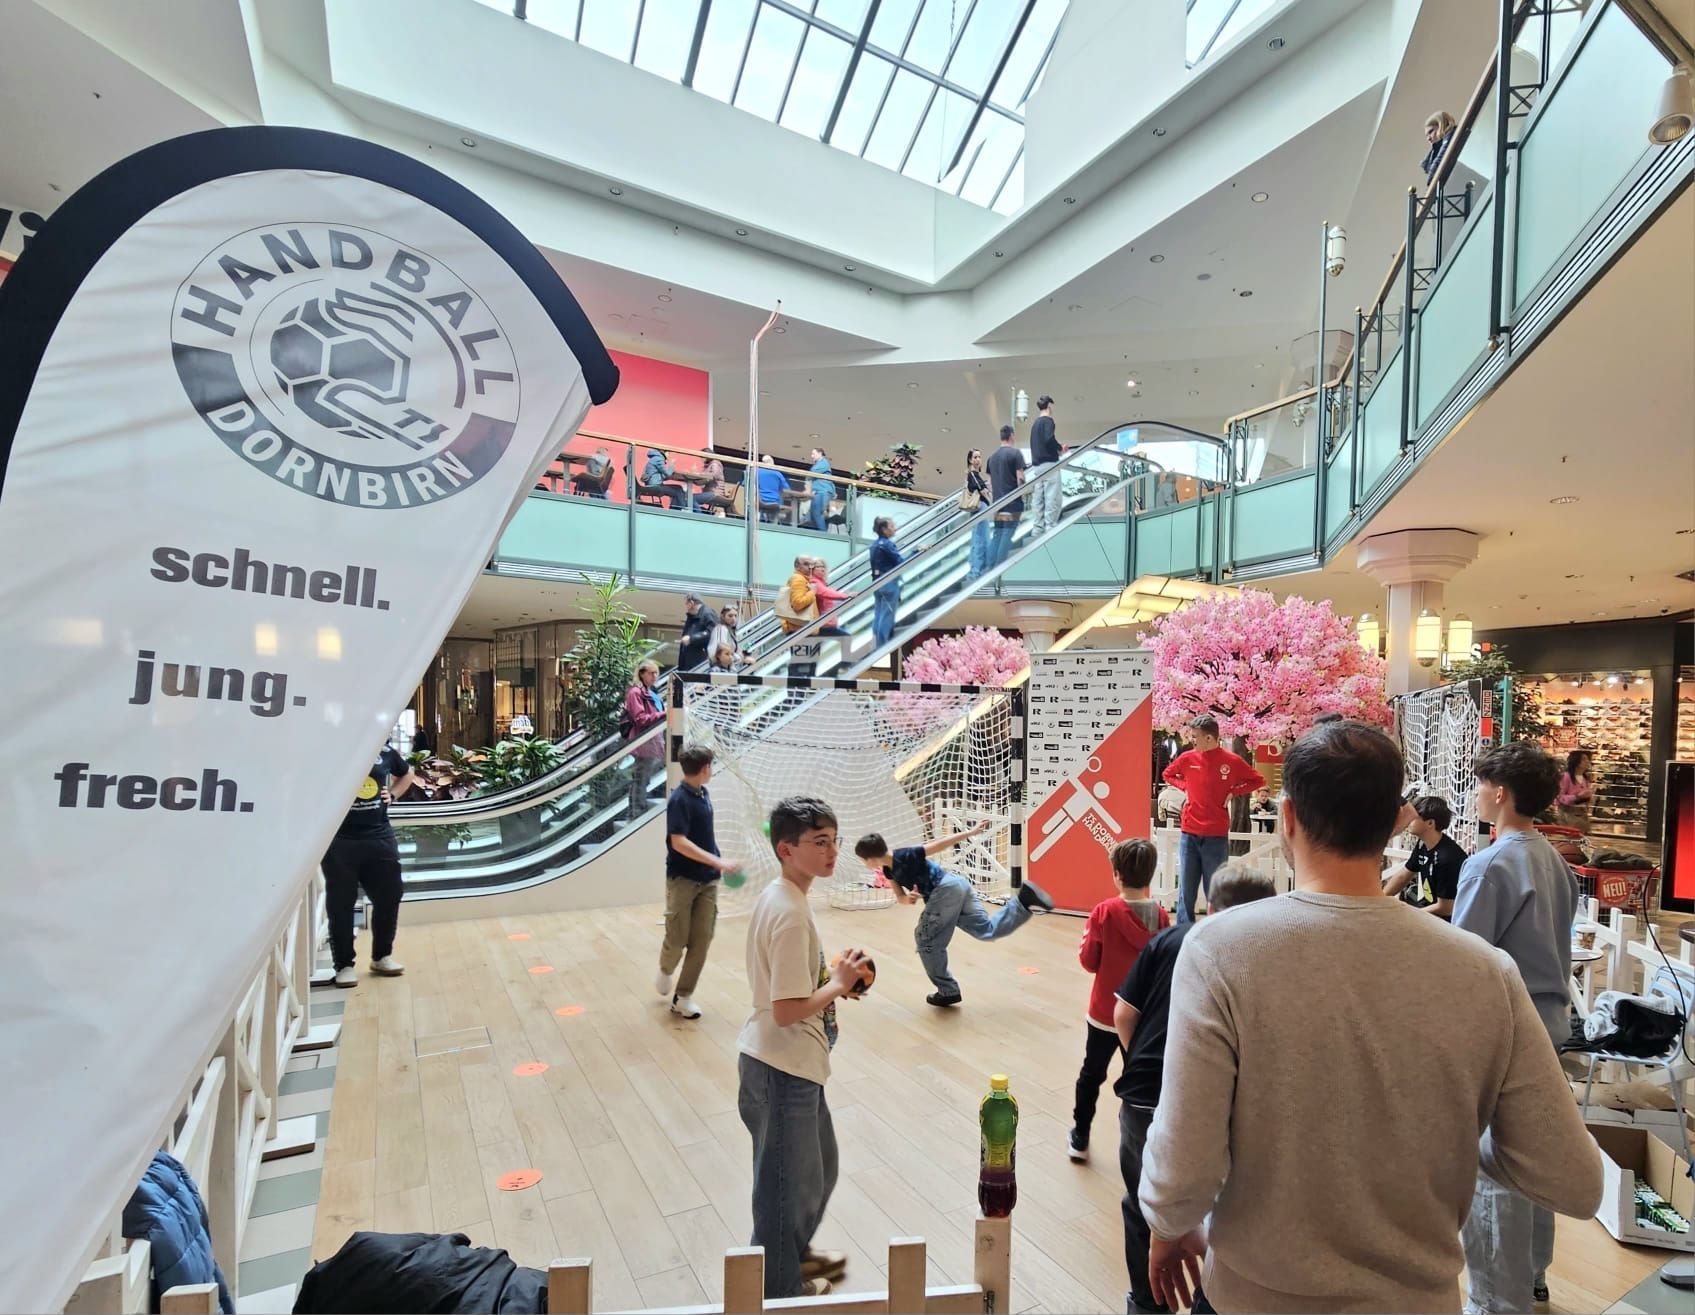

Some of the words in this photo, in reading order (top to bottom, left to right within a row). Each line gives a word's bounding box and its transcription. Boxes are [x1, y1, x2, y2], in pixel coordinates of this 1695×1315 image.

[181, 229, 514, 395] HANDBALL
[206, 401, 474, 506] DORNBIRN
[151, 546, 390, 611] schnell.
[129, 650, 306, 718] jung.
[54, 762, 254, 812] frech.
[1603, 881, 1627, 898] NEU!
